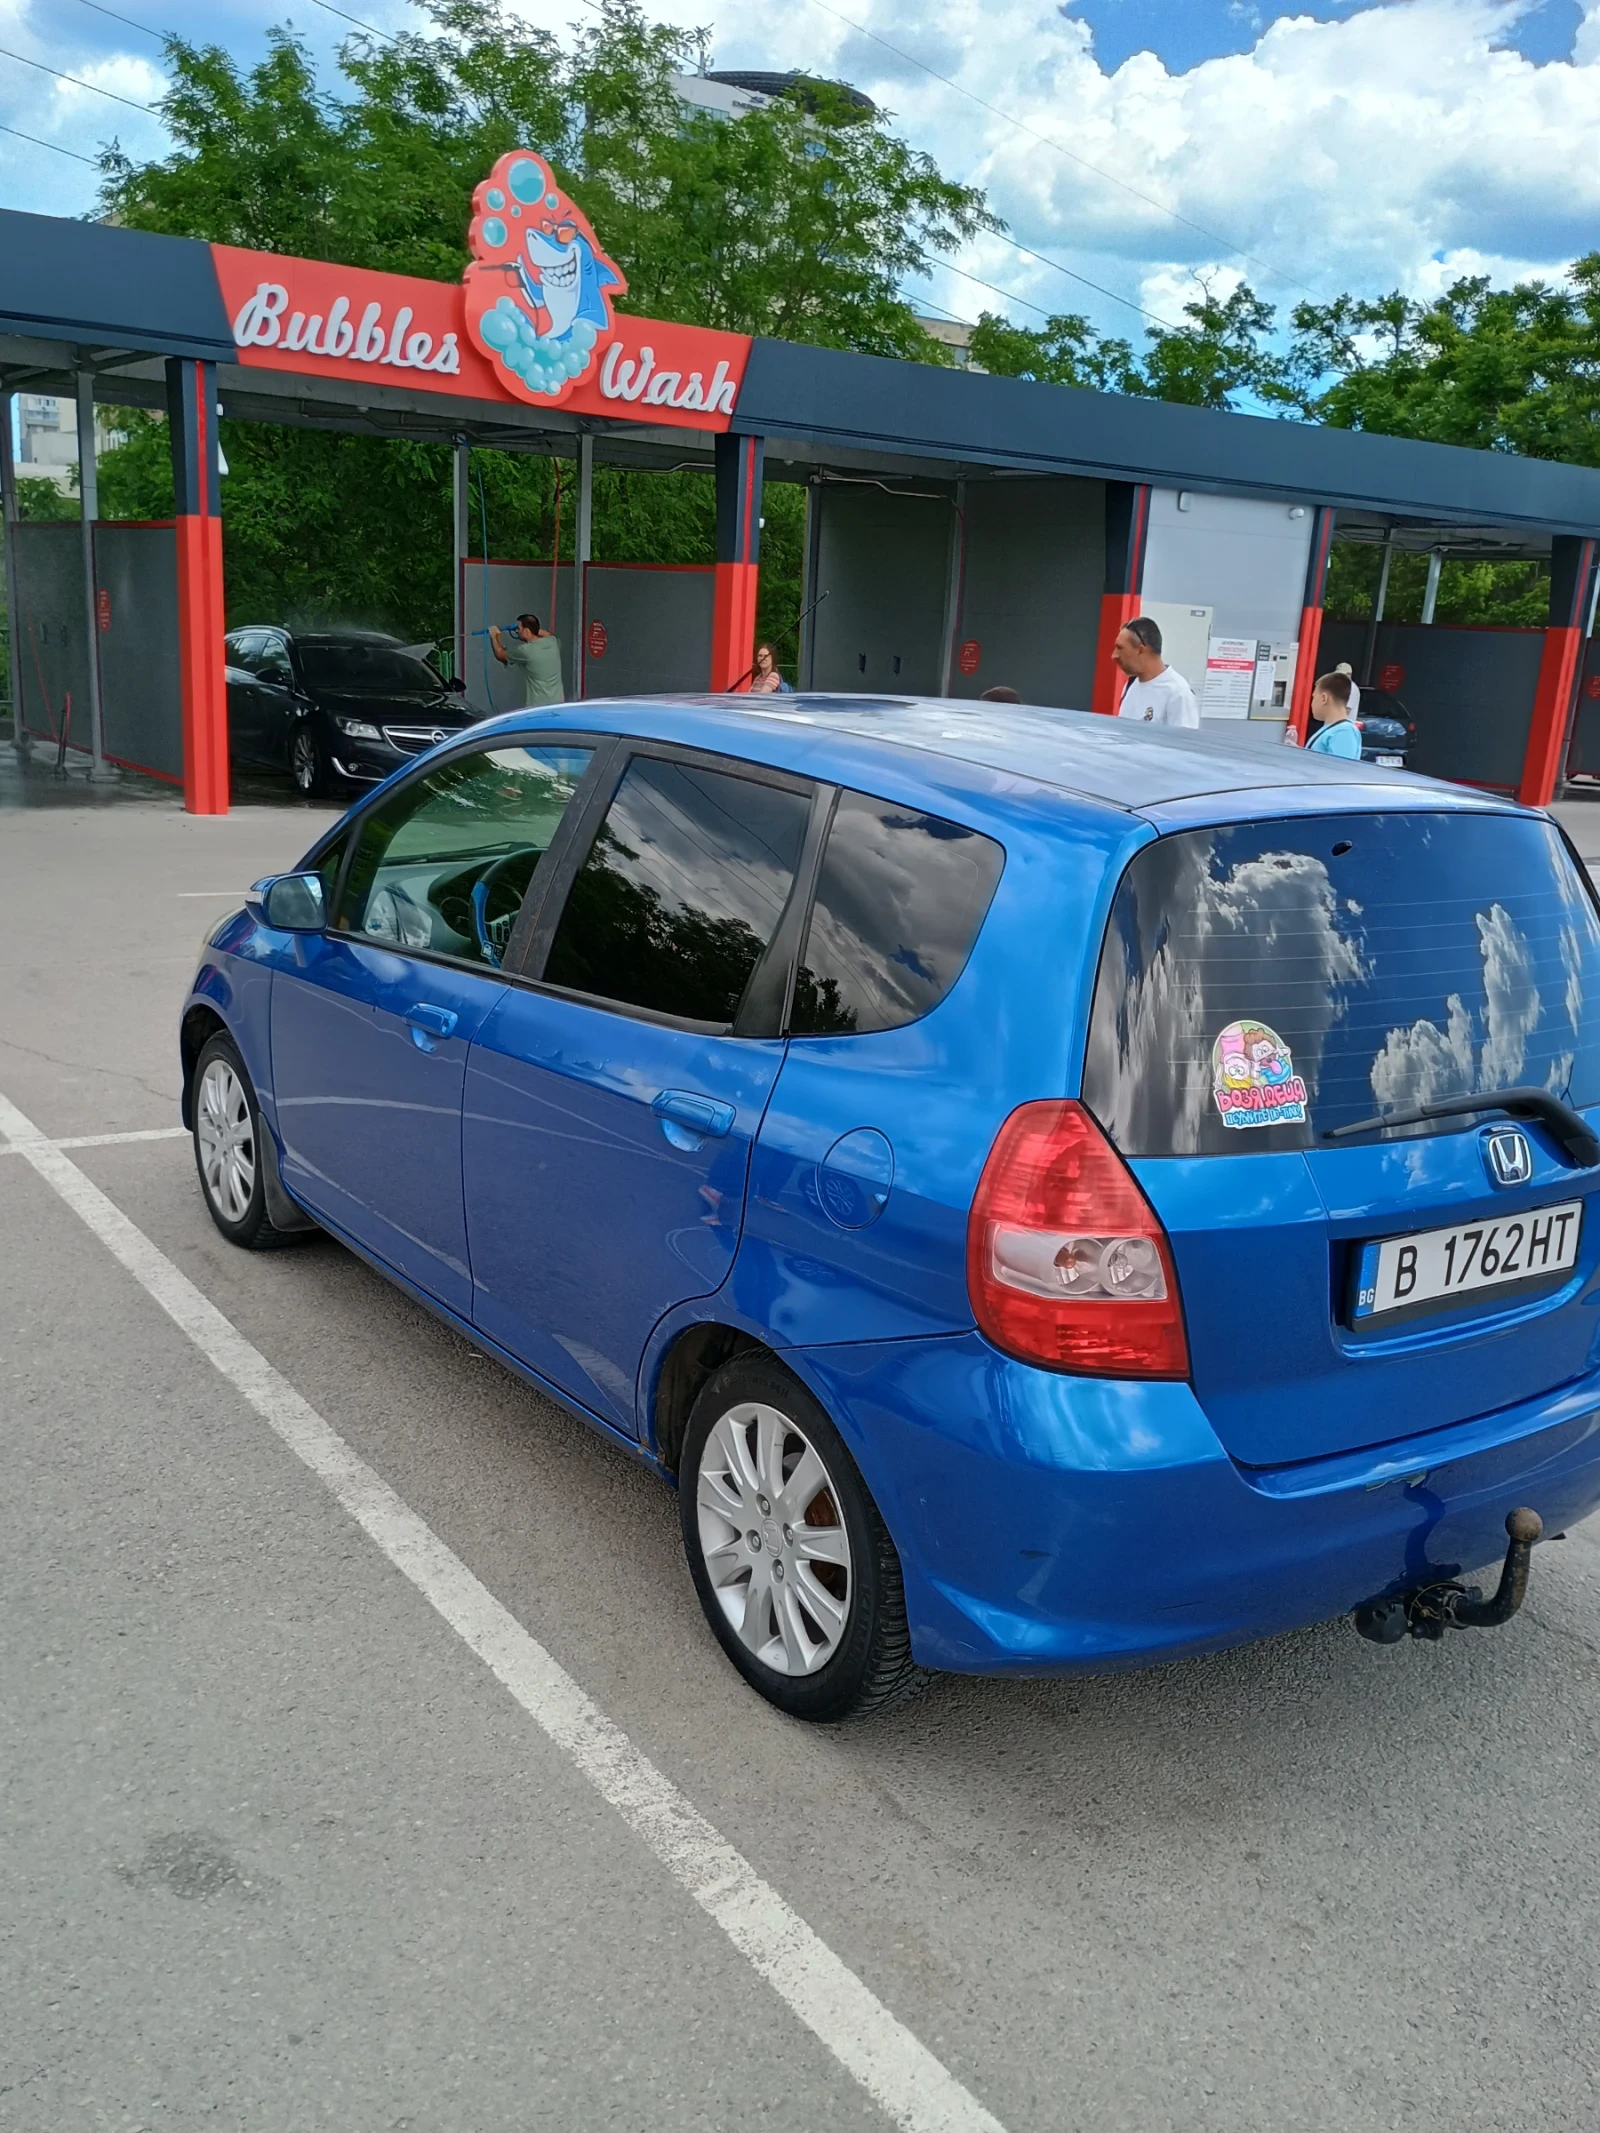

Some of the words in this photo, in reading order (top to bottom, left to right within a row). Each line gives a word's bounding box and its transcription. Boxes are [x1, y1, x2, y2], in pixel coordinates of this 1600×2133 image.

[233, 282, 461, 375] Bubbles
[601, 341, 738, 415] Wash
[1263, 1078, 1305, 1107] ДЕЦА
[1393, 1244, 1418, 1299] B
[1358, 1288, 1375, 1307] BG
